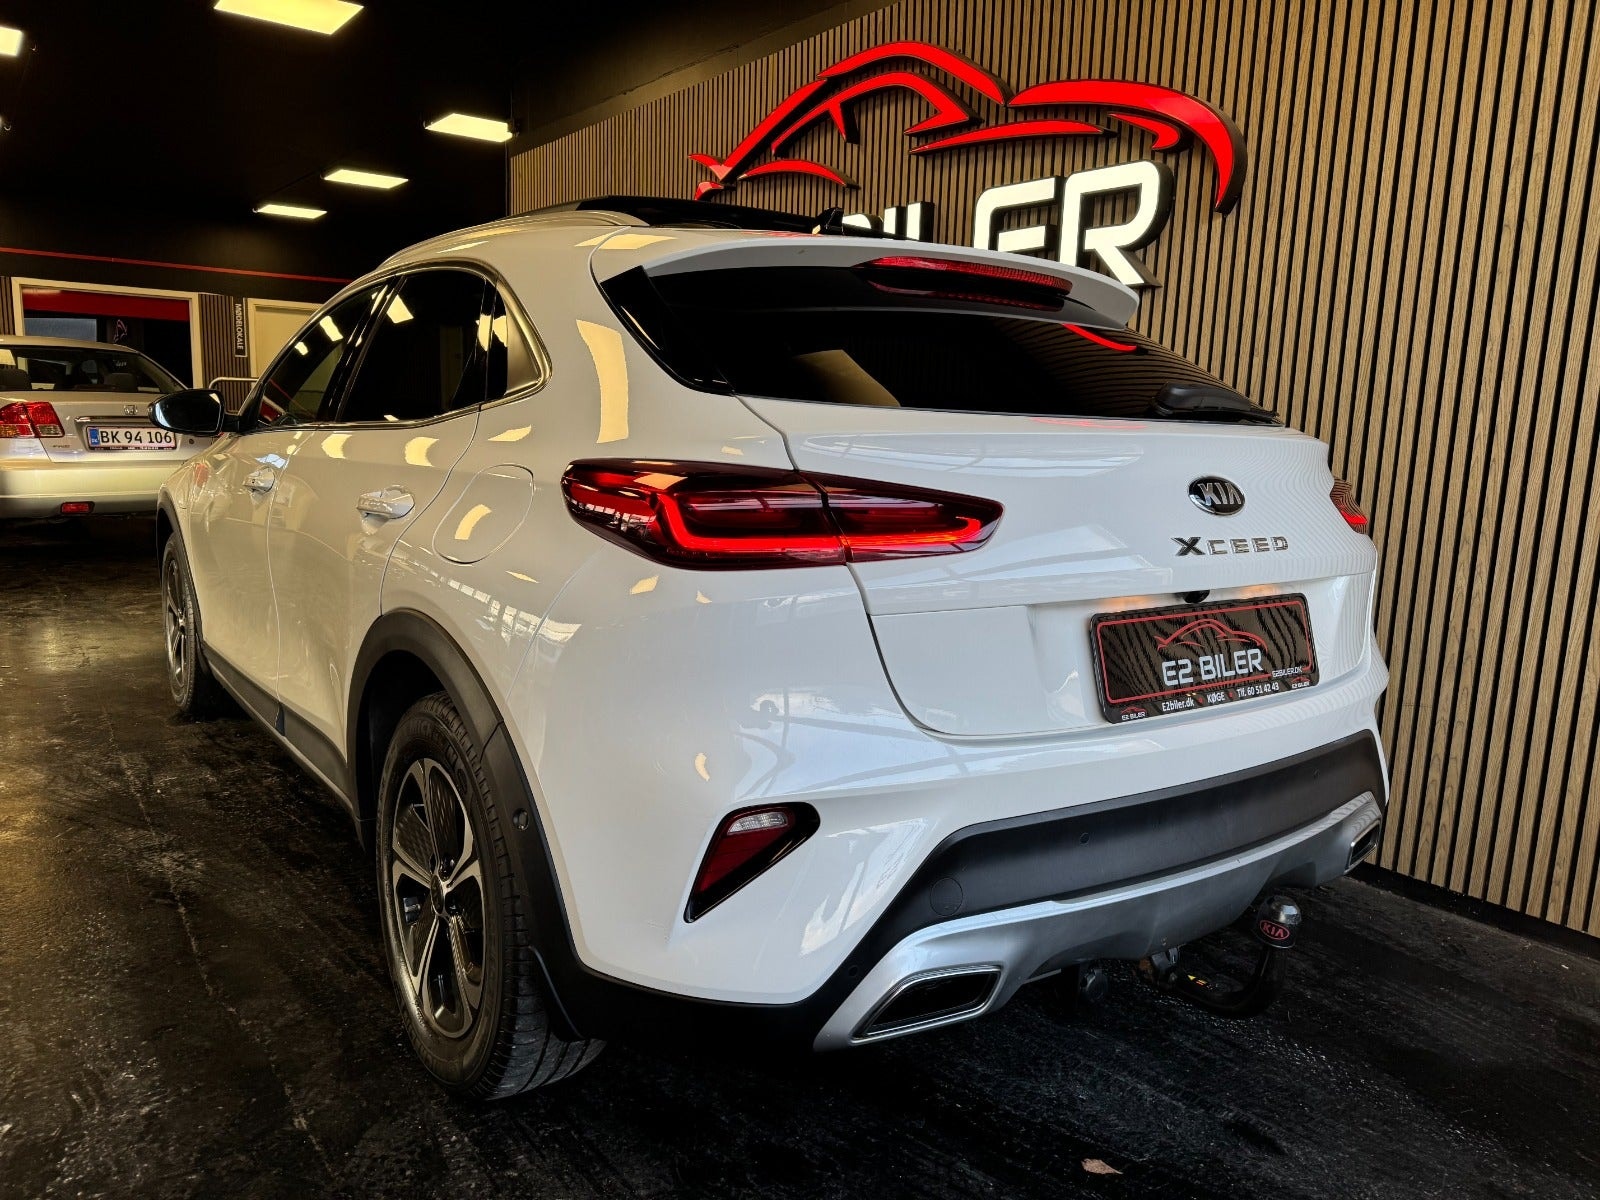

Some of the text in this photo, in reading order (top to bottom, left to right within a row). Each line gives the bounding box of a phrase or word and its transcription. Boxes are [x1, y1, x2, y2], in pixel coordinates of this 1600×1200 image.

[234, 303, 244, 350] MØDELOKALE
[100, 430, 172, 444] BK 94 106
[1197, 482, 1242, 505] KIA
[1171, 536, 1289, 556] XCEED
[1161, 648, 1264, 687] E2 BILER
[1206, 691, 1226, 704] KØGE
[1255, 685, 1263, 695] 51
[1263, 683, 1272, 693] 42
[1271, 681, 1280, 691] 43
[1263, 922, 1285, 938] KIA
